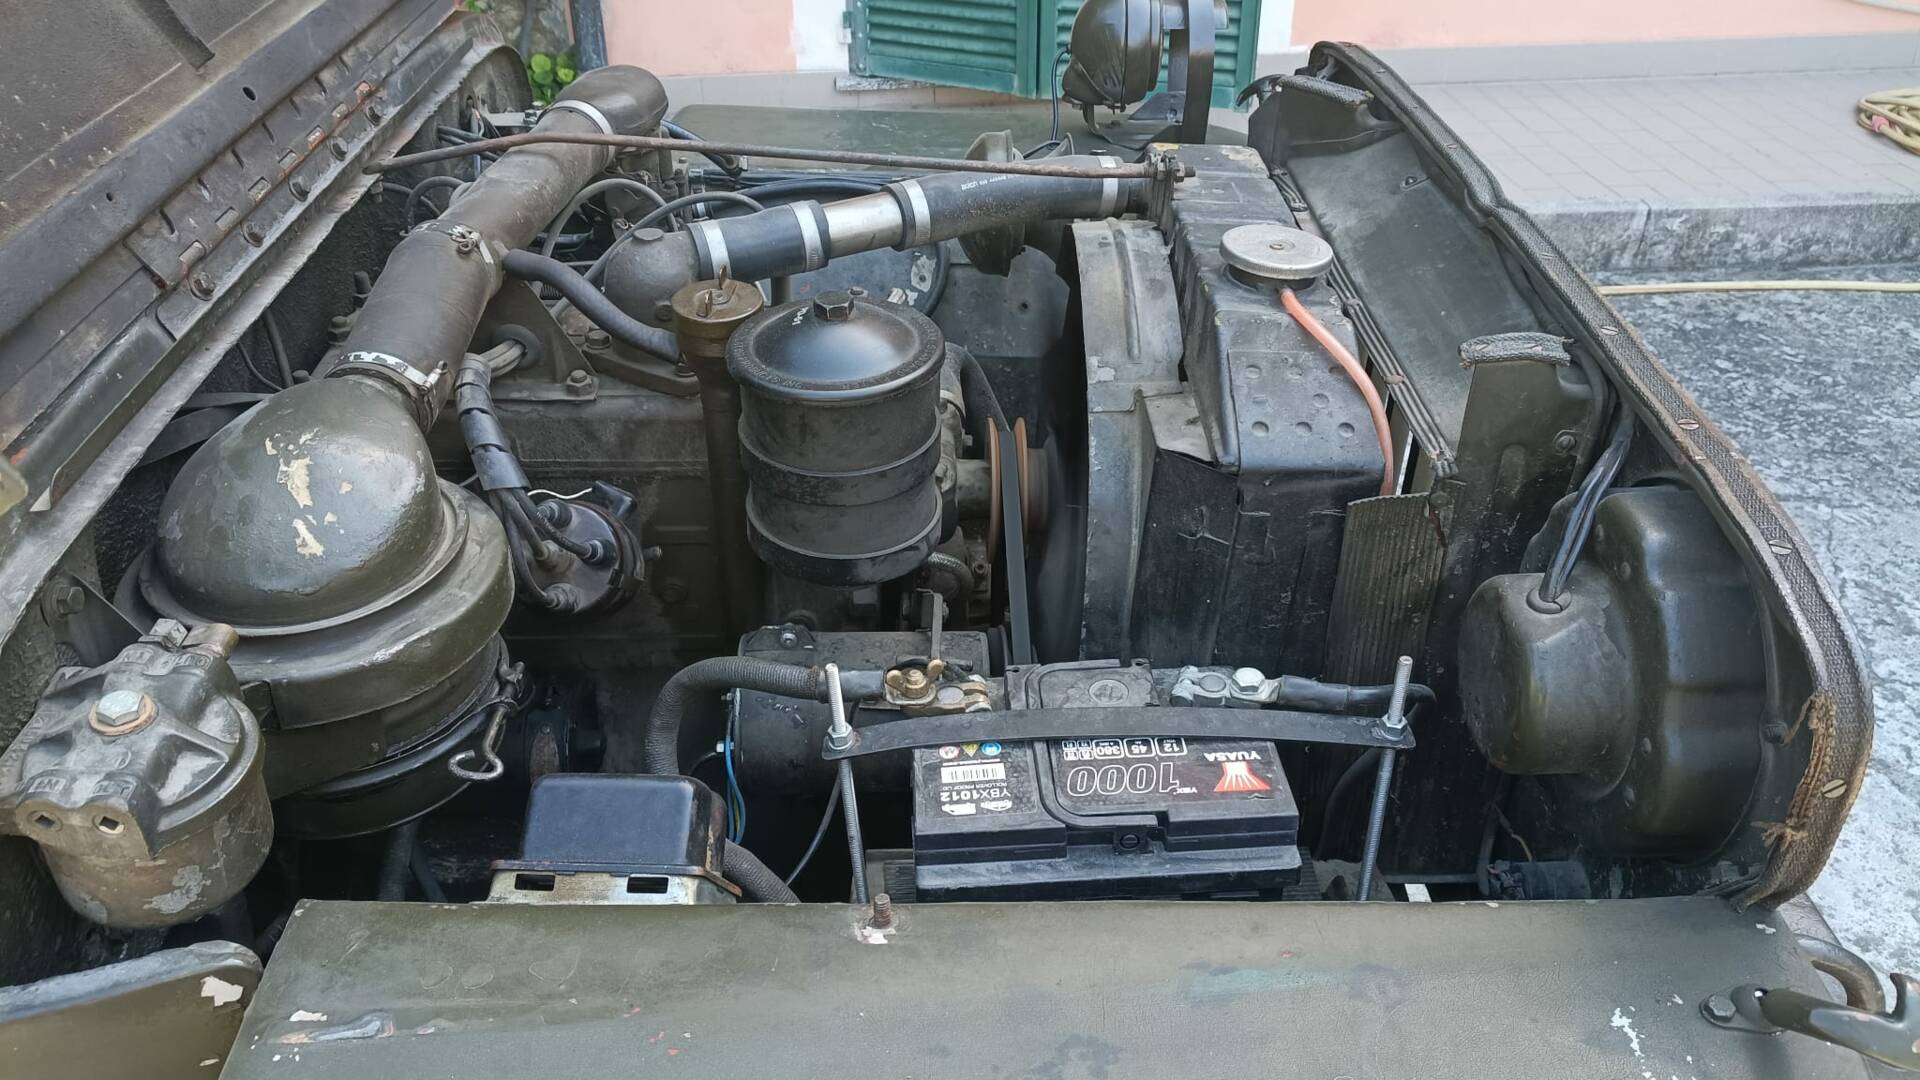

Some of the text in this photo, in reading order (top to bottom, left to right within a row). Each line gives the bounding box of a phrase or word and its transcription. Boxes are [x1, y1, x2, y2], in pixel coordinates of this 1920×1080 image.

[1097, 746, 1121, 755] 380
[1131, 745, 1147, 754] 45
[1163, 743, 1180, 752] 12
[1204, 751, 1262, 761] YUASA
[1067, 762, 1180, 796] 1000
[940, 787, 1012, 801] YBX1012
